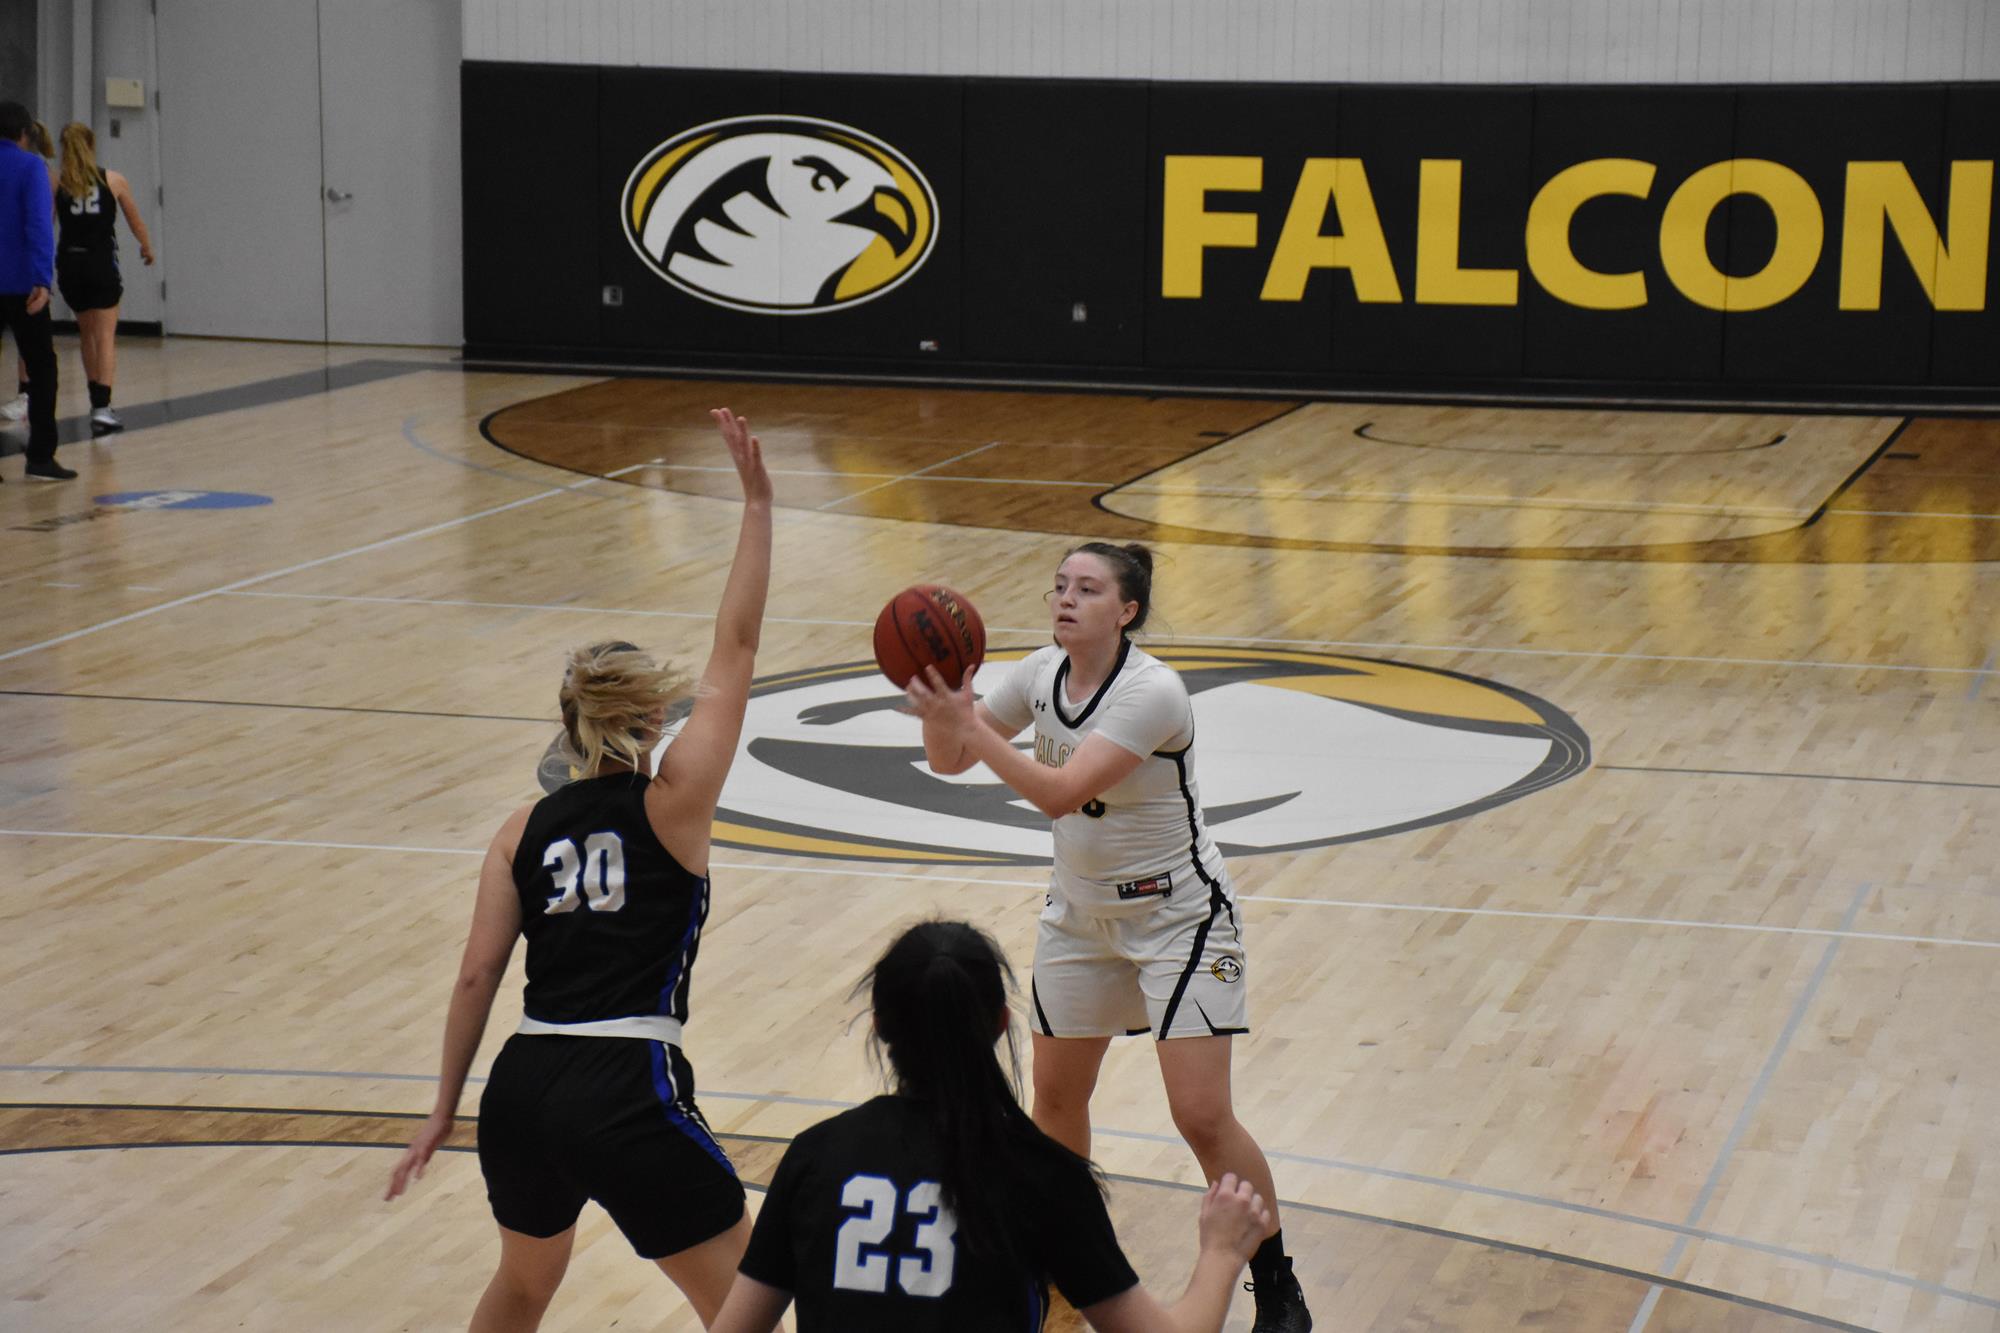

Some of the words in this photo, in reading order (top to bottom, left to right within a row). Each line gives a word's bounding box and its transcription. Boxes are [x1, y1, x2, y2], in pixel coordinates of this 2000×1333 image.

[1161, 154, 1995, 312] FALCON
[542, 830, 626, 915] 30
[832, 1174, 959, 1298] 23
